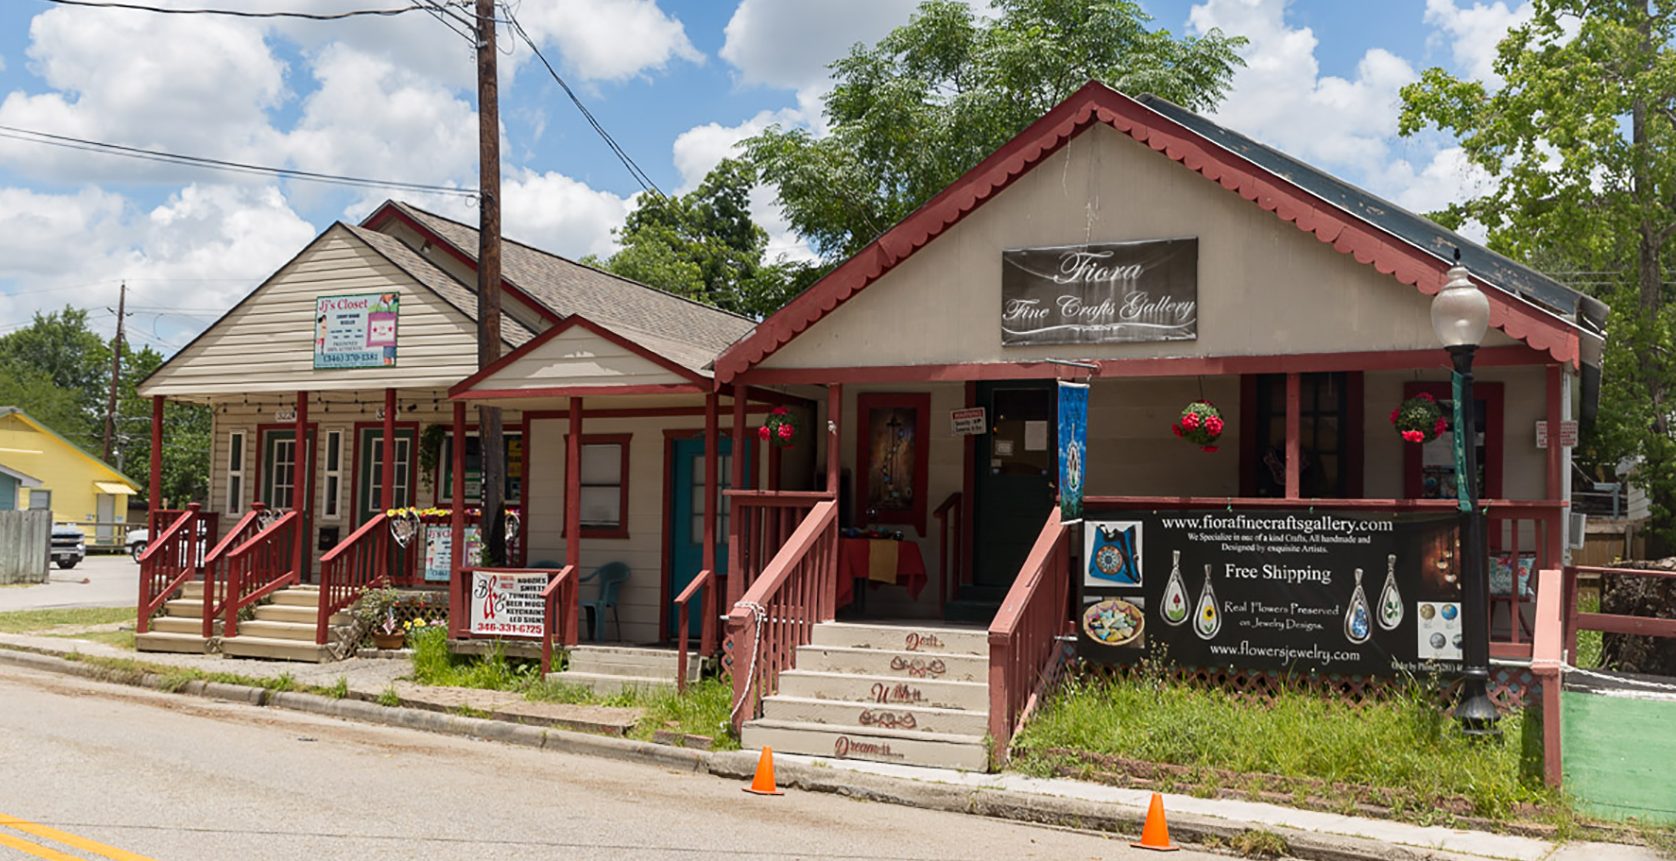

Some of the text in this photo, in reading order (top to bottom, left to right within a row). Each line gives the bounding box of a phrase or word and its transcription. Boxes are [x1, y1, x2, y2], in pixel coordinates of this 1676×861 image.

[1053, 251, 1143, 284] Fiora
[319, 299, 368, 313] Jj's Closet
[1002, 290, 1195, 323] Fine Crafts Gallery
[1161, 514, 1394, 534] www.fiorafinecraftsgallery.com
[1187, 532, 1199, 541] We
[1199, 532, 1232, 543] Specialize
[1268, 533, 1284, 542] kind
[1309, 534, 1321, 543] All
[1321, 534, 1356, 544] handmade
[1357, 535, 1371, 544] and
[1221, 543, 1256, 553] Designed
[1256, 544, 1266, 554] by
[1266, 544, 1301, 554] exquisite
[1225, 563, 1332, 585] Free Shipping
[1224, 601, 1340, 616] Real Flowers Preserved
[1251, 617, 1285, 631] Jewelry
[1210, 640, 1360, 667] www.flowersjewelry.com
